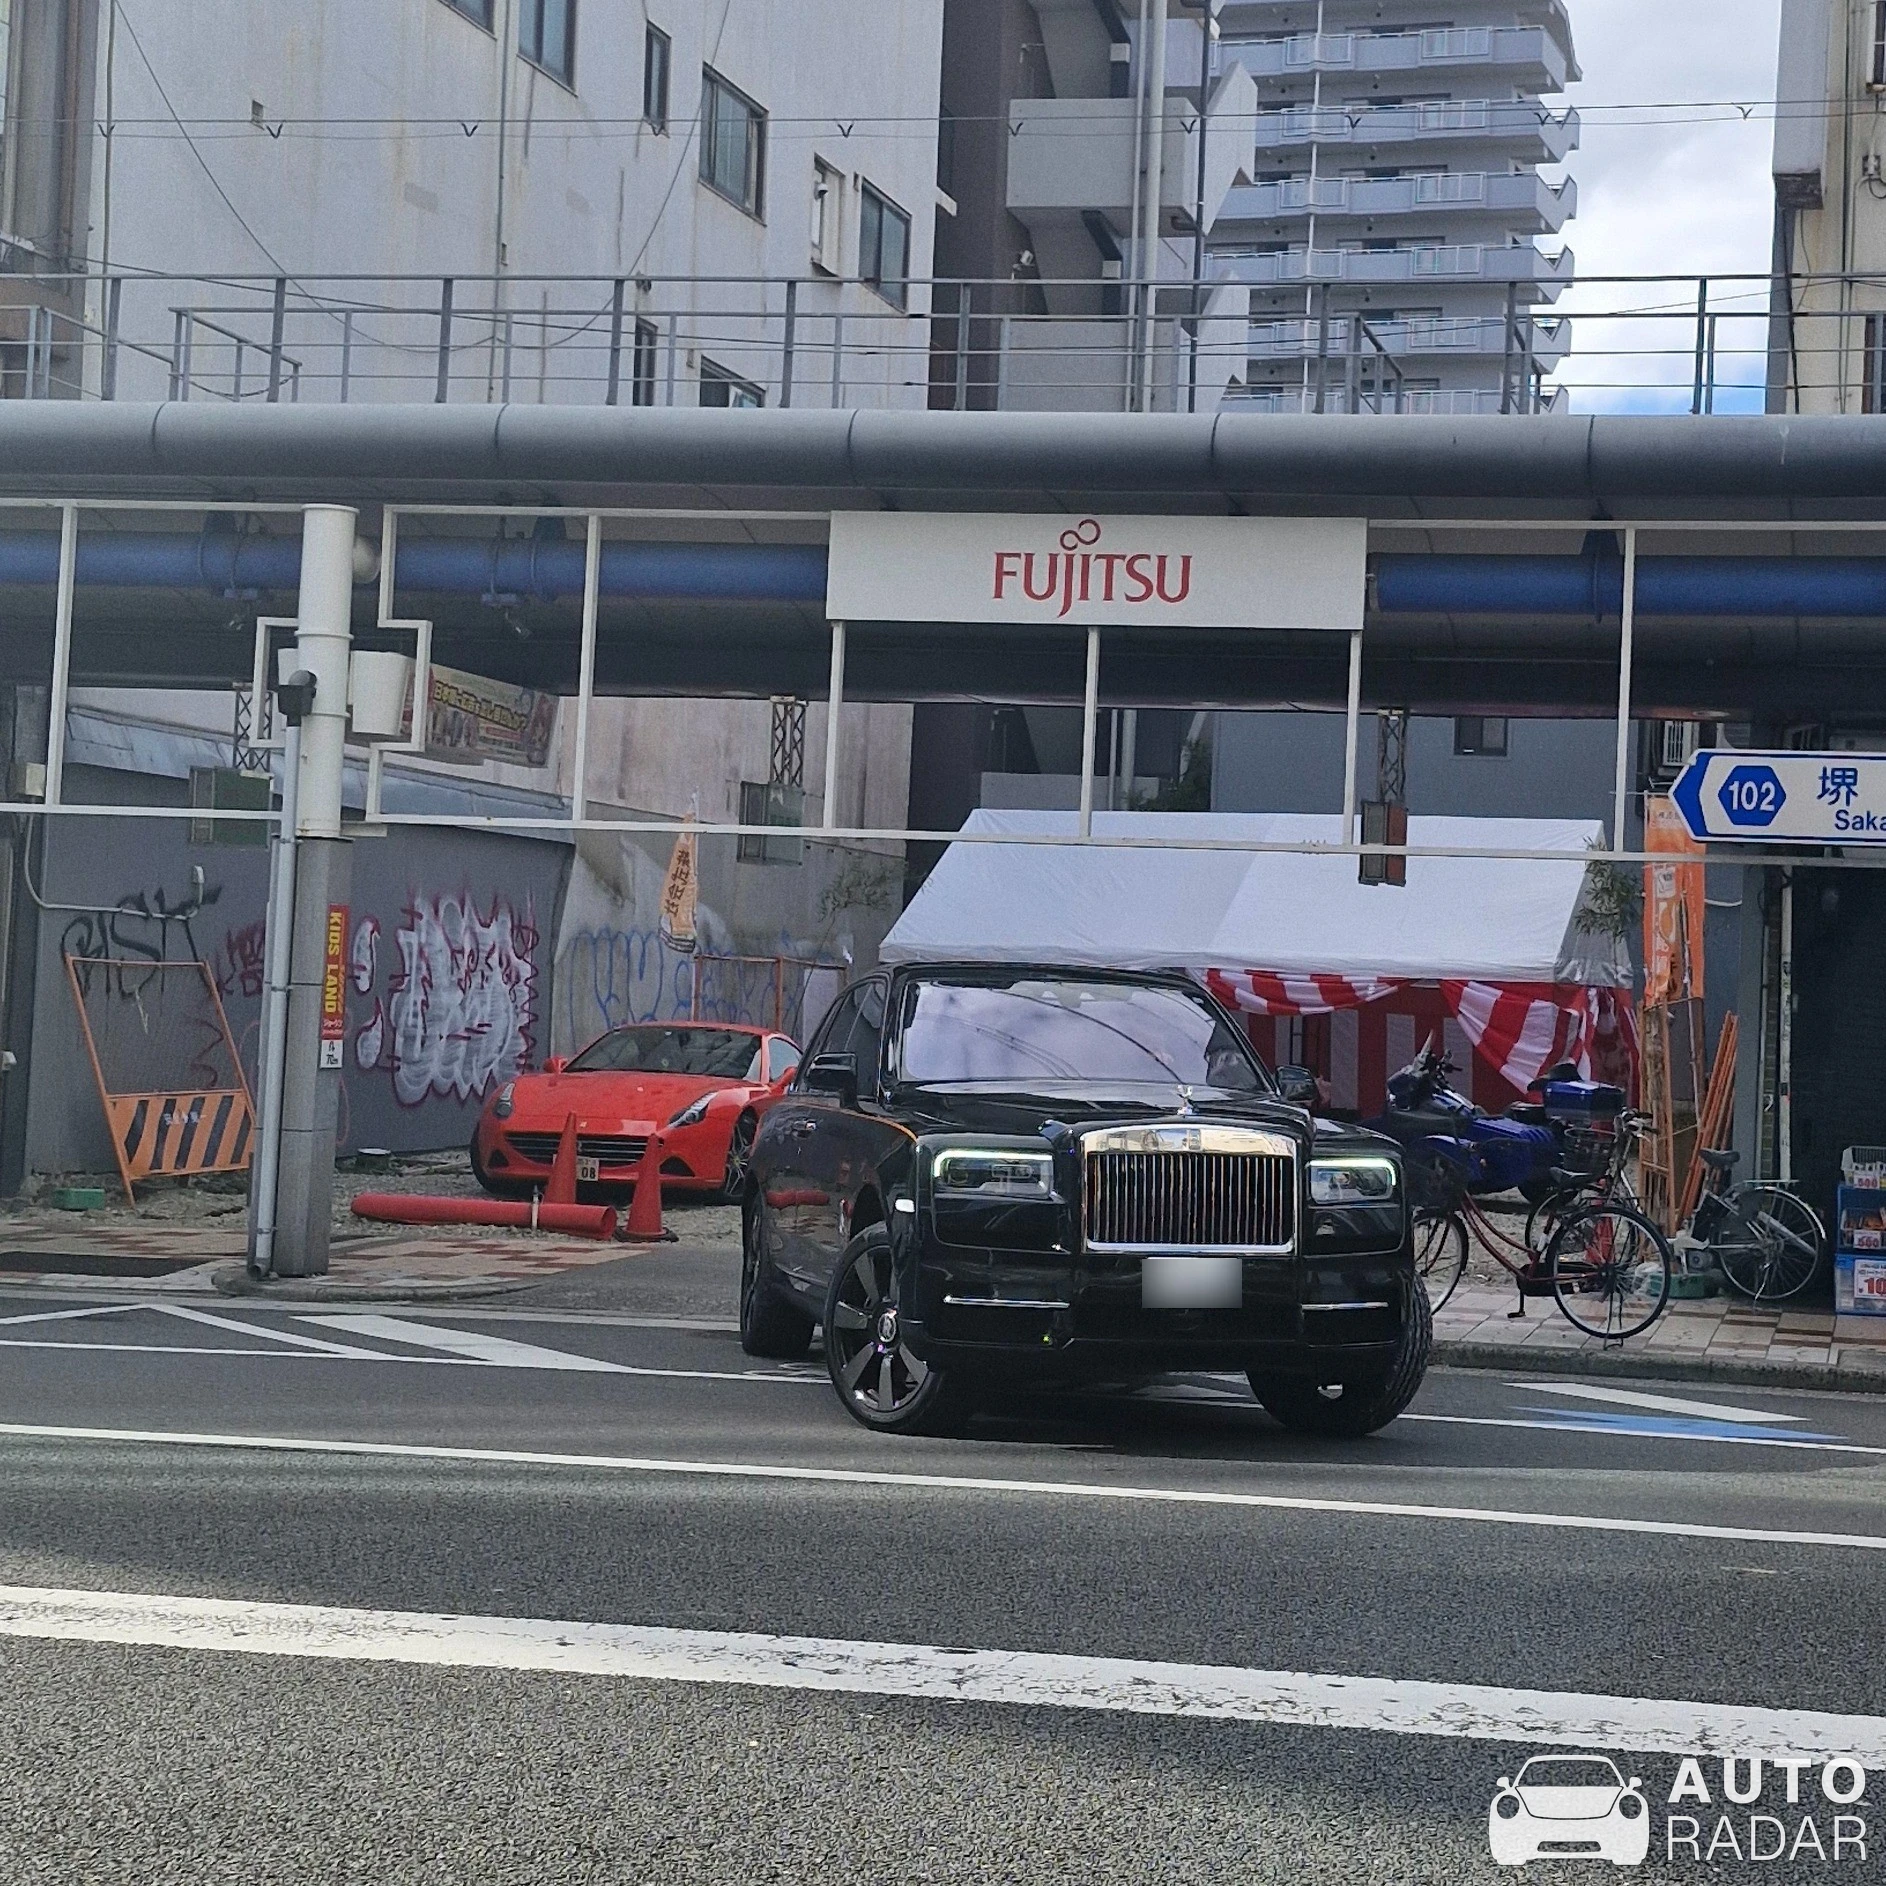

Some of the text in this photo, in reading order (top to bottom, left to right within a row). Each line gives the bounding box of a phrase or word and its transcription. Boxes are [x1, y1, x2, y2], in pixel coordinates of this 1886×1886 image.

[993, 552, 1193, 619] FUJITSU
[1728, 766, 1859, 812] 102 堺
[328, 912, 343, 956] KIDS
[325, 964, 339, 1013] LAND
